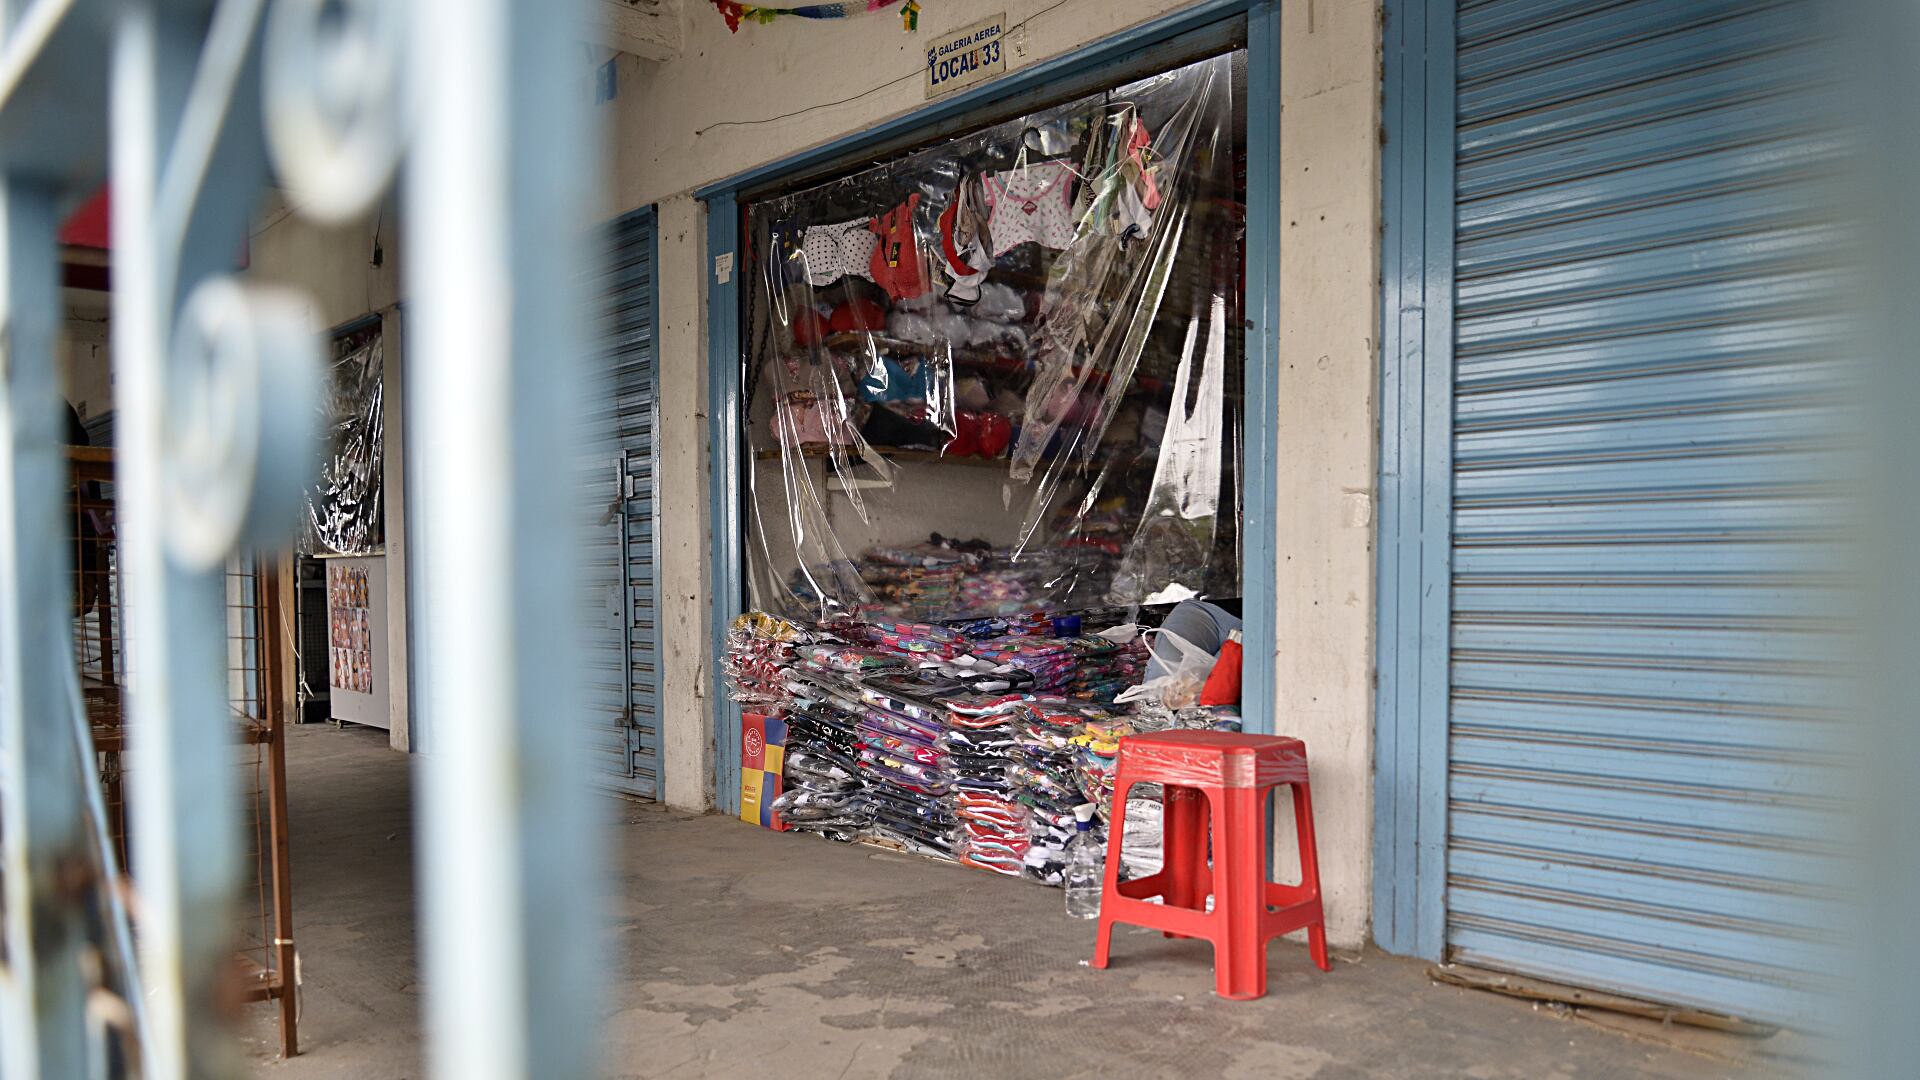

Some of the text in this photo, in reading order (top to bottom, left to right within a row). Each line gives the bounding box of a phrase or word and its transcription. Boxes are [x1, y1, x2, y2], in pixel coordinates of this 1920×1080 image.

[939, 24, 1001, 56] GALERIA AEREA
[931, 41, 1000, 85] LOCAL 33
